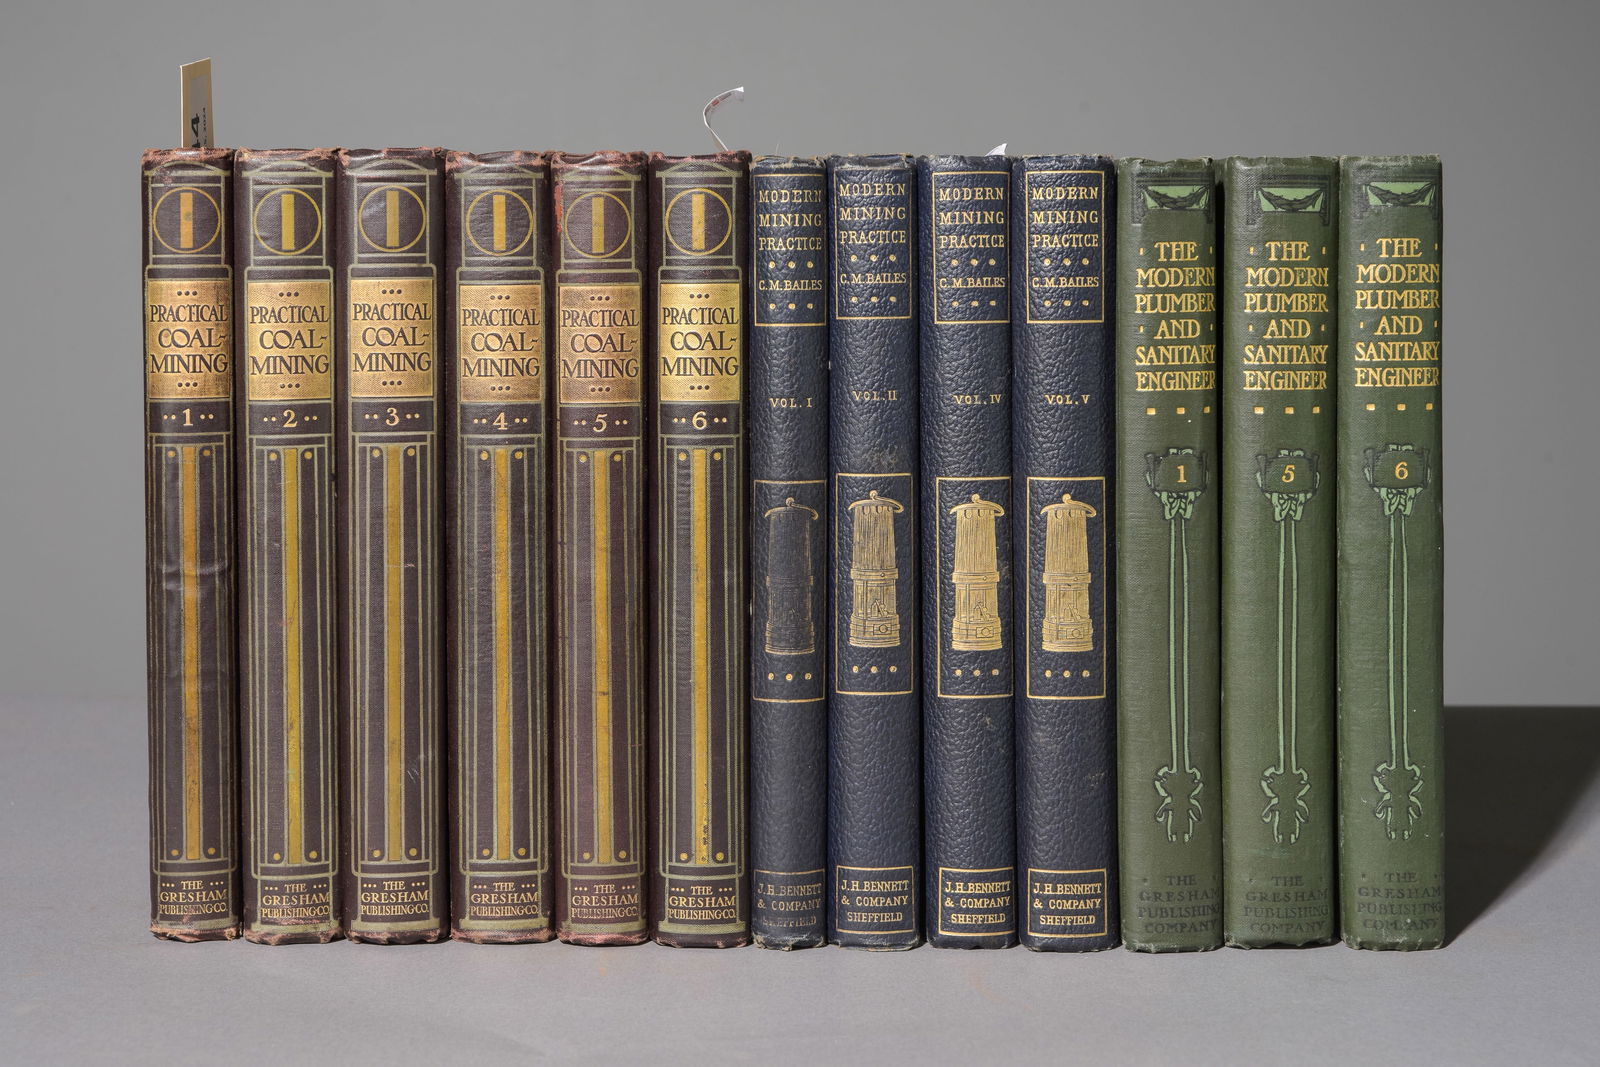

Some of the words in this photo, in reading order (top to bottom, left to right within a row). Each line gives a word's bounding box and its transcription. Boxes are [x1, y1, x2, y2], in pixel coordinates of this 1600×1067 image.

[759, 189, 822, 204] MODERN
[840, 183, 906, 197] MODERN
[939, 187, 1004, 202] MODERN
[1032, 186, 1099, 200] MODERN
[759, 213, 822, 228] MINING
[840, 207, 906, 221] MINING
[939, 211, 1005, 225] MINING
[1032, 210, 1099, 224] MINING
[759, 237, 822, 251] PRACTICE
[840, 231, 906, 245] PRACTICE
[939, 234, 1005, 249] PRACTICE
[1032, 234, 1099, 248] PRACTICE
[1154, 241, 1198, 262] THE
[1265, 240, 1310, 262] THE
[1376, 237, 1422, 258] THE
[1135, 267, 1216, 288] MODERN
[1245, 266, 1329, 287] MODERN
[1356, 263, 1440, 284] MODERN
[1135, 293, 1216, 314] PLUMBER
[1244, 292, 1329, 313] PLUMBER
[1354, 289, 1440, 309] PLUMBER
[150, 304, 228, 322] PRACTICAL
[250, 305, 329, 324] PRACTICAL
[352, 303, 431, 320] PRACTICAL
[462, 308, 540, 327] PRACTICAL
[561, 309, 640, 327] PRACTICAL
[661, 307, 739, 326] PRACTICAL
[1153, 319, 1200, 340] AND
[1263, 318, 1311, 339] AND
[1374, 315, 1422, 335] AND
[158, 328, 226, 348] COAL-
[259, 329, 328, 349] COAL-
[362, 327, 430, 346] COAL-
[470, 332, 540, 352] COAL-
[570, 333, 638, 352] COAL-
[670, 331, 737, 351] COAL-
[1135, 344, 1216, 366] SANITARY
[1243, 344, 1328, 365] SANITARY
[1354, 341, 1440, 361] SANITARY
[150, 353, 228, 373] MINING
[250, 355, 329, 375] MINING
[352, 352, 431, 372] MINING
[462, 358, 540, 377] MINING
[561, 358, 639, 379] MINING
[661, 356, 739, 377] MINING
[1135, 370, 1216, 392] ENGINEER
[1243, 370, 1328, 391] ENGINEER
[1354, 367, 1440, 388] ENGINEER
[182, 408, 193, 426] 1
[283, 410, 297, 427] 2
[386, 408, 400, 426] 3
[492, 413, 508, 430] 4
[593, 413, 608, 432] 5
[692, 411, 707, 430] 6
[1176, 465, 1187, 483] 1
[1282, 464, 1296, 483] 5
[1394, 462, 1409, 480] 6
[181, 880, 204, 890] THE
[383, 880, 406, 891] THE
[1166, 875, 1197, 886] THE
[1271, 876, 1304, 887] THE
[1384, 872, 1417, 882] THE
[284, 883, 307, 893] THE
[493, 881, 516, 892] THE
[593, 884, 616, 894] THE
[691, 885, 713, 896] THE
[1246, 888, 1329, 902] GRESHAM
[160, 889, 228, 903] GRESHAM
[262, 892, 330, 906] GRESHAM
[361, 890, 428, 904] GRESHAM
[470, 892, 539, 904] GRESHAM
[572, 893, 639, 906] GRESHAM
[669, 895, 737, 908] GRESHAM
[757, 899, 766, 909] &
[771, 898, 822, 911] COMPANY
[841, 895, 850, 906] &
[855, 895, 909, 907] COMPANY
[945, 896, 956, 907] &
[959, 895, 1011, 908] COMPANY
[1033, 898, 1043, 909] &
[1048, 897, 1102, 910] COMPANY
[847, 911, 903, 923] SHEFFIELD
[950, 912, 1006, 925] SHEFFIELD
[1039, 914, 1096, 926] SHEFFIELD
